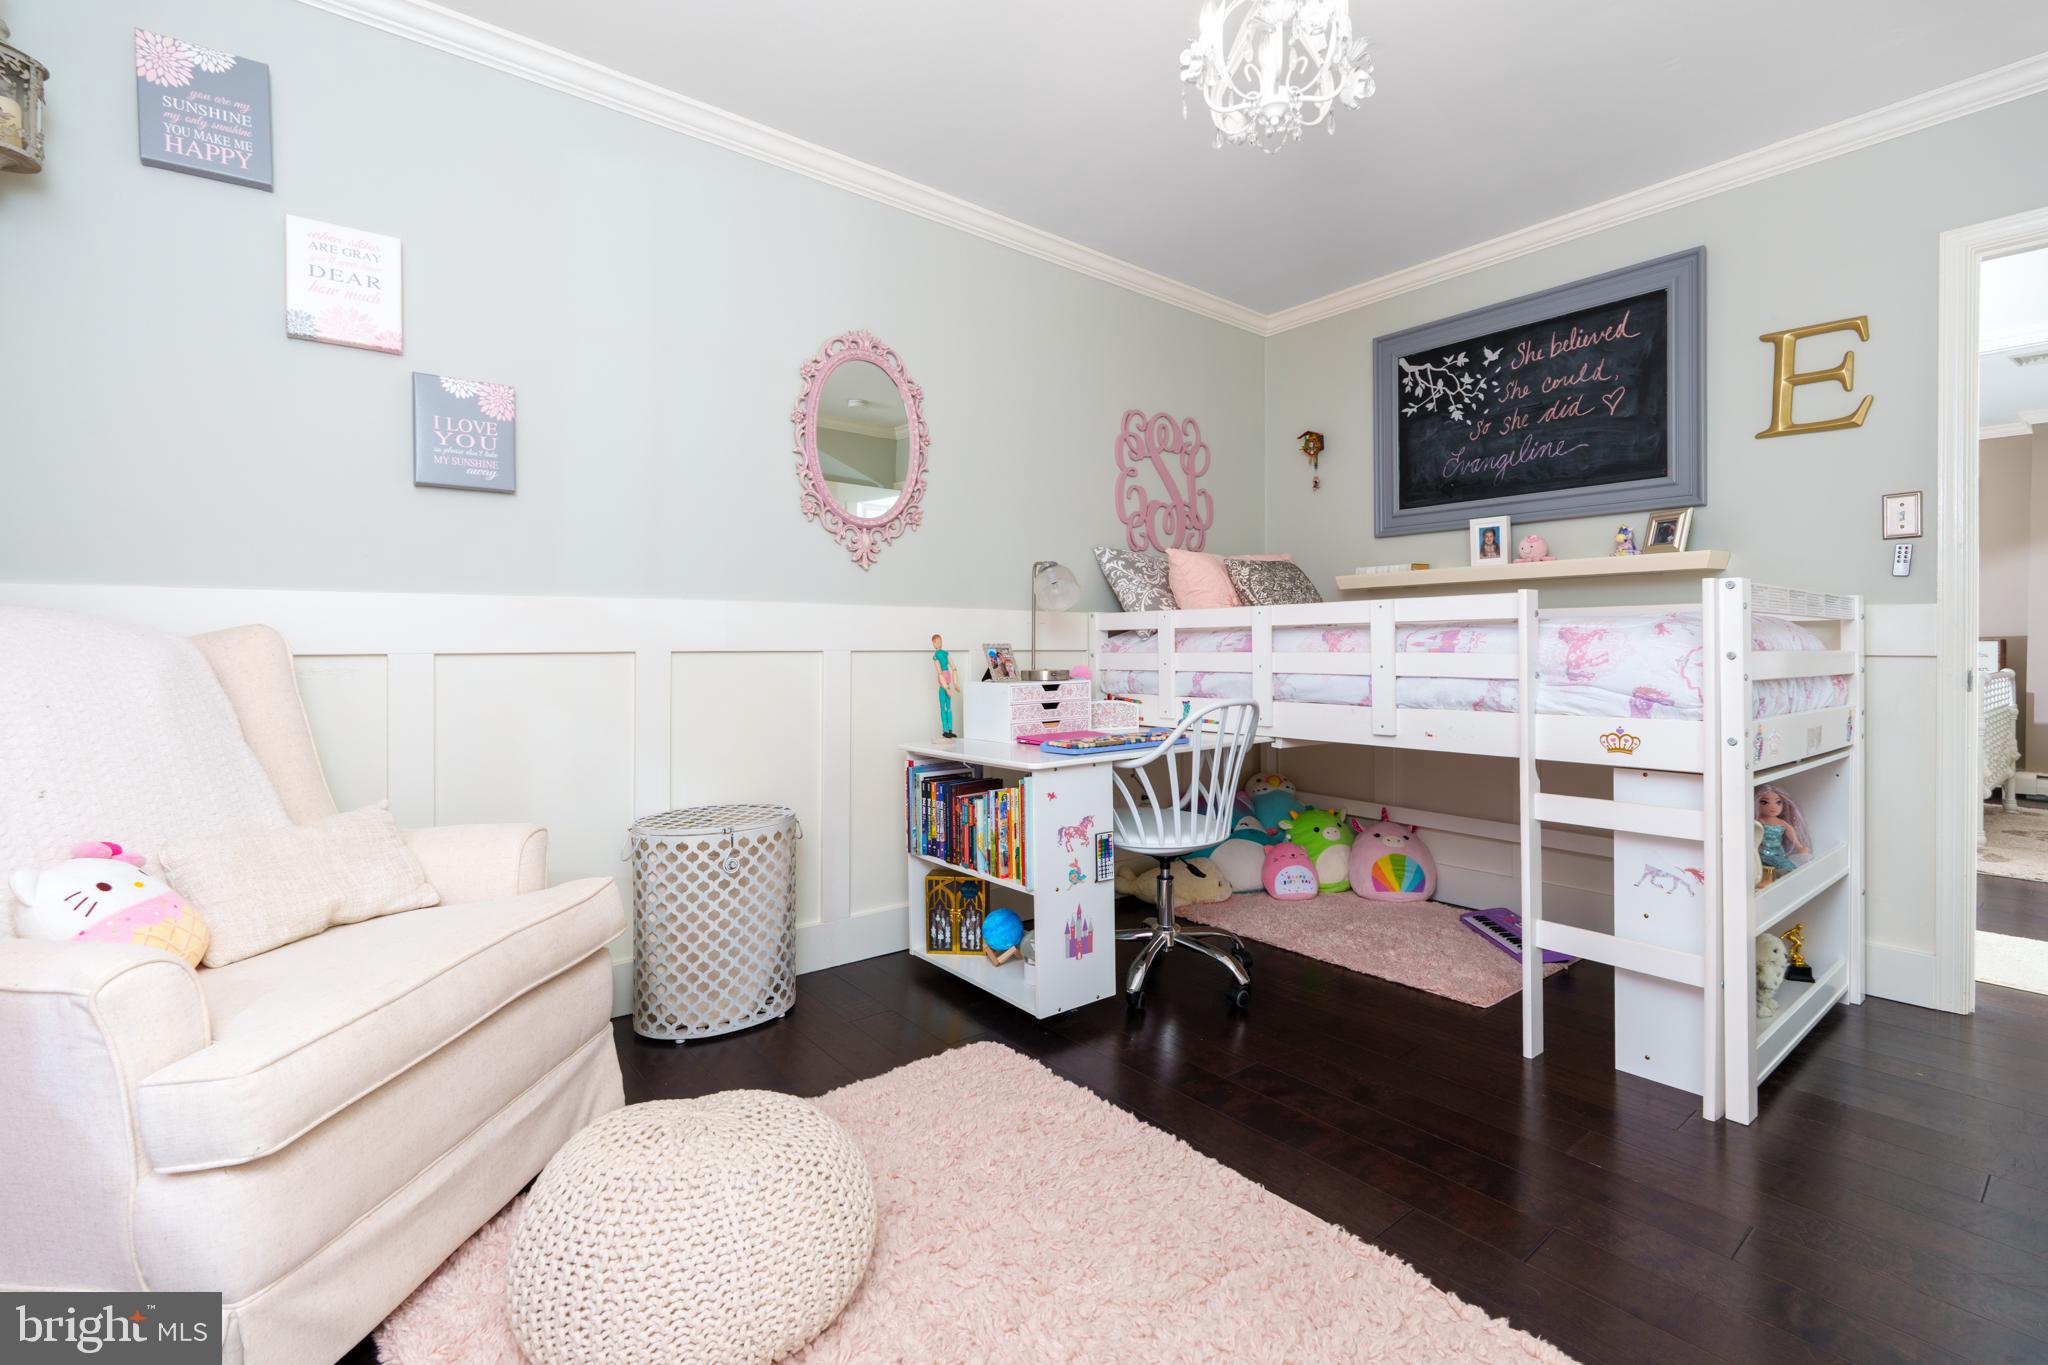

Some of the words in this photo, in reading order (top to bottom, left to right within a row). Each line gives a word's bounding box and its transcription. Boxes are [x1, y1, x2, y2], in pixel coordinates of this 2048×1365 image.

[162, 95, 253, 128] SUNSHINE
[163, 110, 180, 124] my
[185, 115, 208, 130] only
[163, 122, 191, 137] YOU
[194, 129, 231, 147] MAKE
[234, 138, 253, 153] ME
[164, 133, 253, 170] HAPPY
[308, 241, 338, 255] ARE
[342, 247, 382, 263] GRAY
[308, 263, 381, 290] DEAR
[1511, 340, 1545, 370] She
[1550, 309, 1641, 360] believed
[1755, 315, 1874, 439] E
[1537, 393, 1595, 424] did
[433, 415, 440, 430] I
[446, 416, 498, 436] LOVE
[433, 430, 497, 451] YOU
[451, 456, 499, 470] SUNSHINE
[1442, 433, 1590, 486] Evangeline
